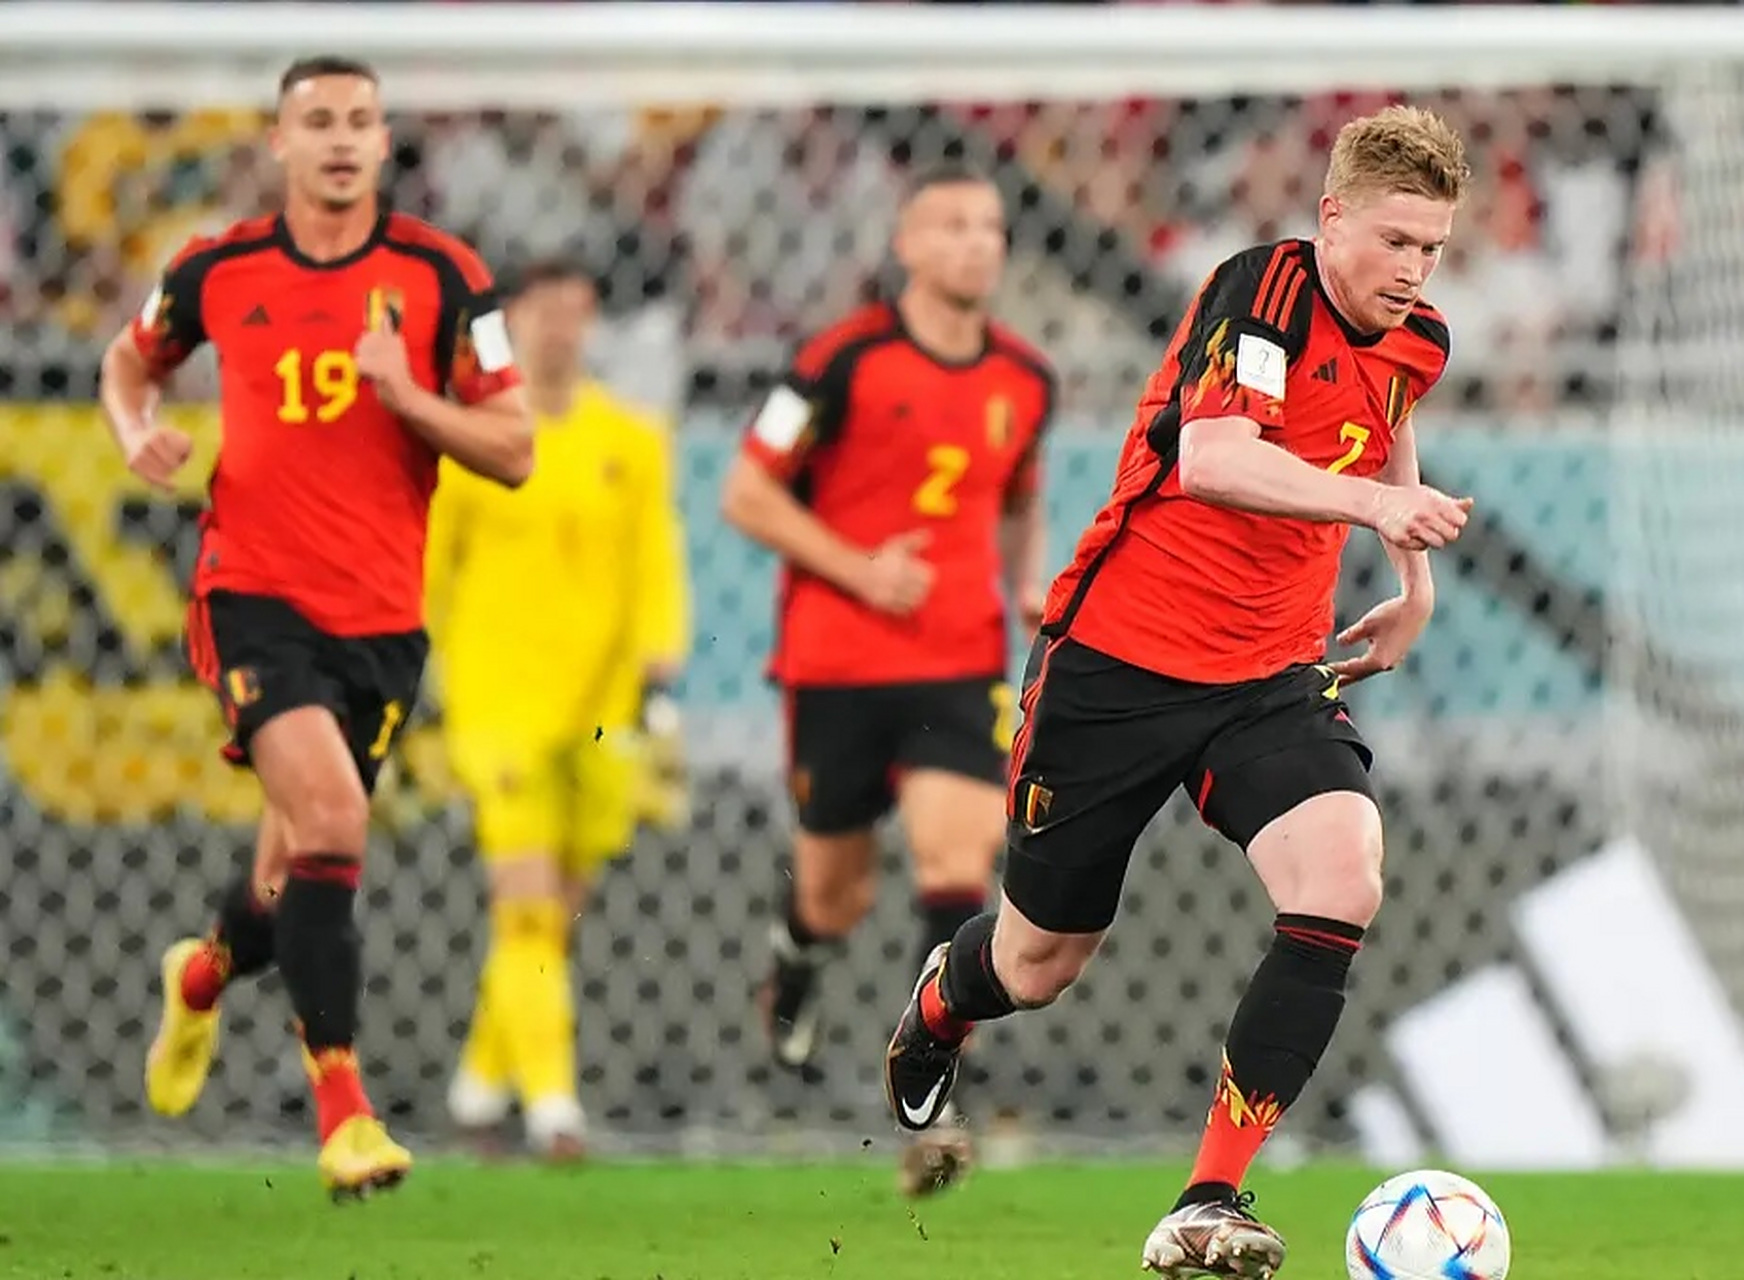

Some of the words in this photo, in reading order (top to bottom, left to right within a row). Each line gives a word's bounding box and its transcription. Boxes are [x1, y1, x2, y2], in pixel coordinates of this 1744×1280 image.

[275, 348, 359, 423] 19
[913, 445, 970, 517] 2
[1328, 421, 1371, 475] 7
